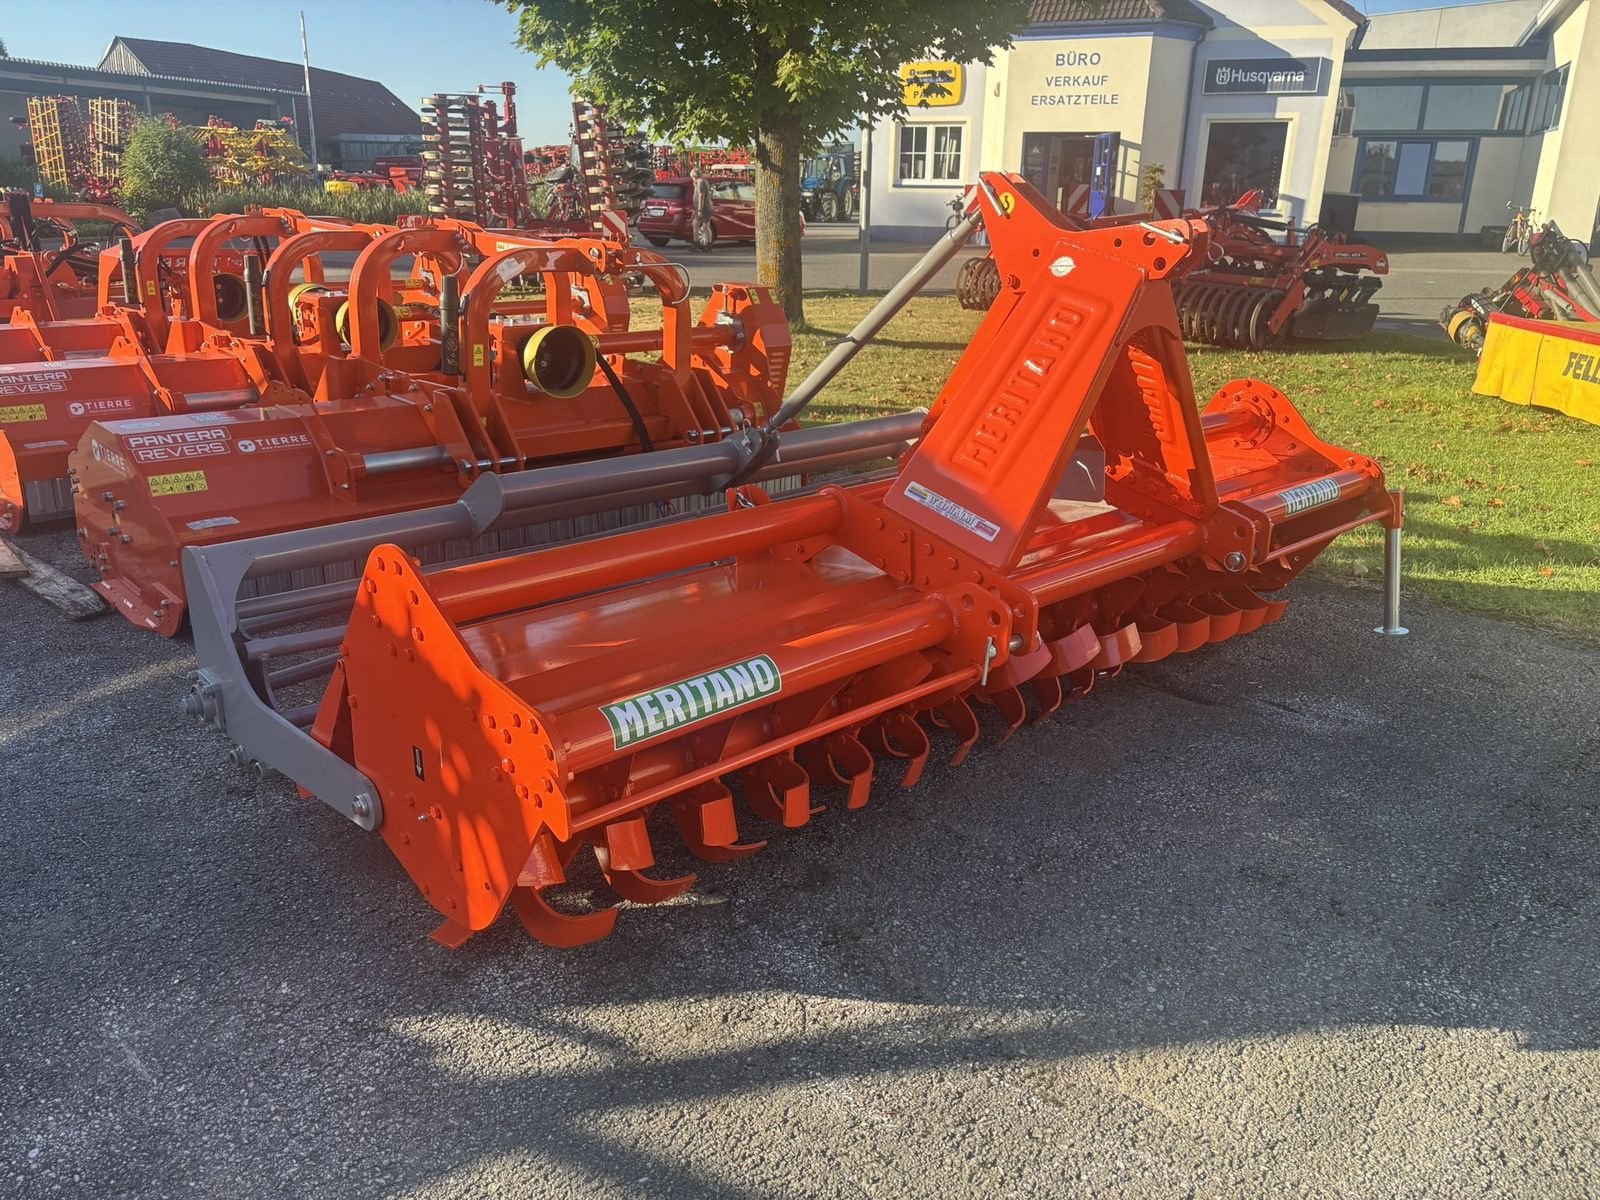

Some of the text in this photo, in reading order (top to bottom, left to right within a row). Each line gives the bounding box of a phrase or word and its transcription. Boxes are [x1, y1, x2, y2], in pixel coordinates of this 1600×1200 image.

[1055, 50, 1101, 67] BÜRO
[1045, 75, 1109, 87] VERKAUF
[1231, 69, 1305, 85] Husqvarna
[1031, 94, 1119, 106] ERSATZTEILE
[1561, 351, 1600, 385] FELL
[0, 371, 68, 384] ANTERA
[0, 382, 63, 395] EVERS
[958, 306, 1085, 470] MERITANO
[84, 399, 132, 411] TIERRE
[128, 428, 226, 449] PANTERA
[255, 434, 309, 447] TIERRE
[137, 441, 225, 461] REVERS
[609, 658, 775, 744] MERITANO
